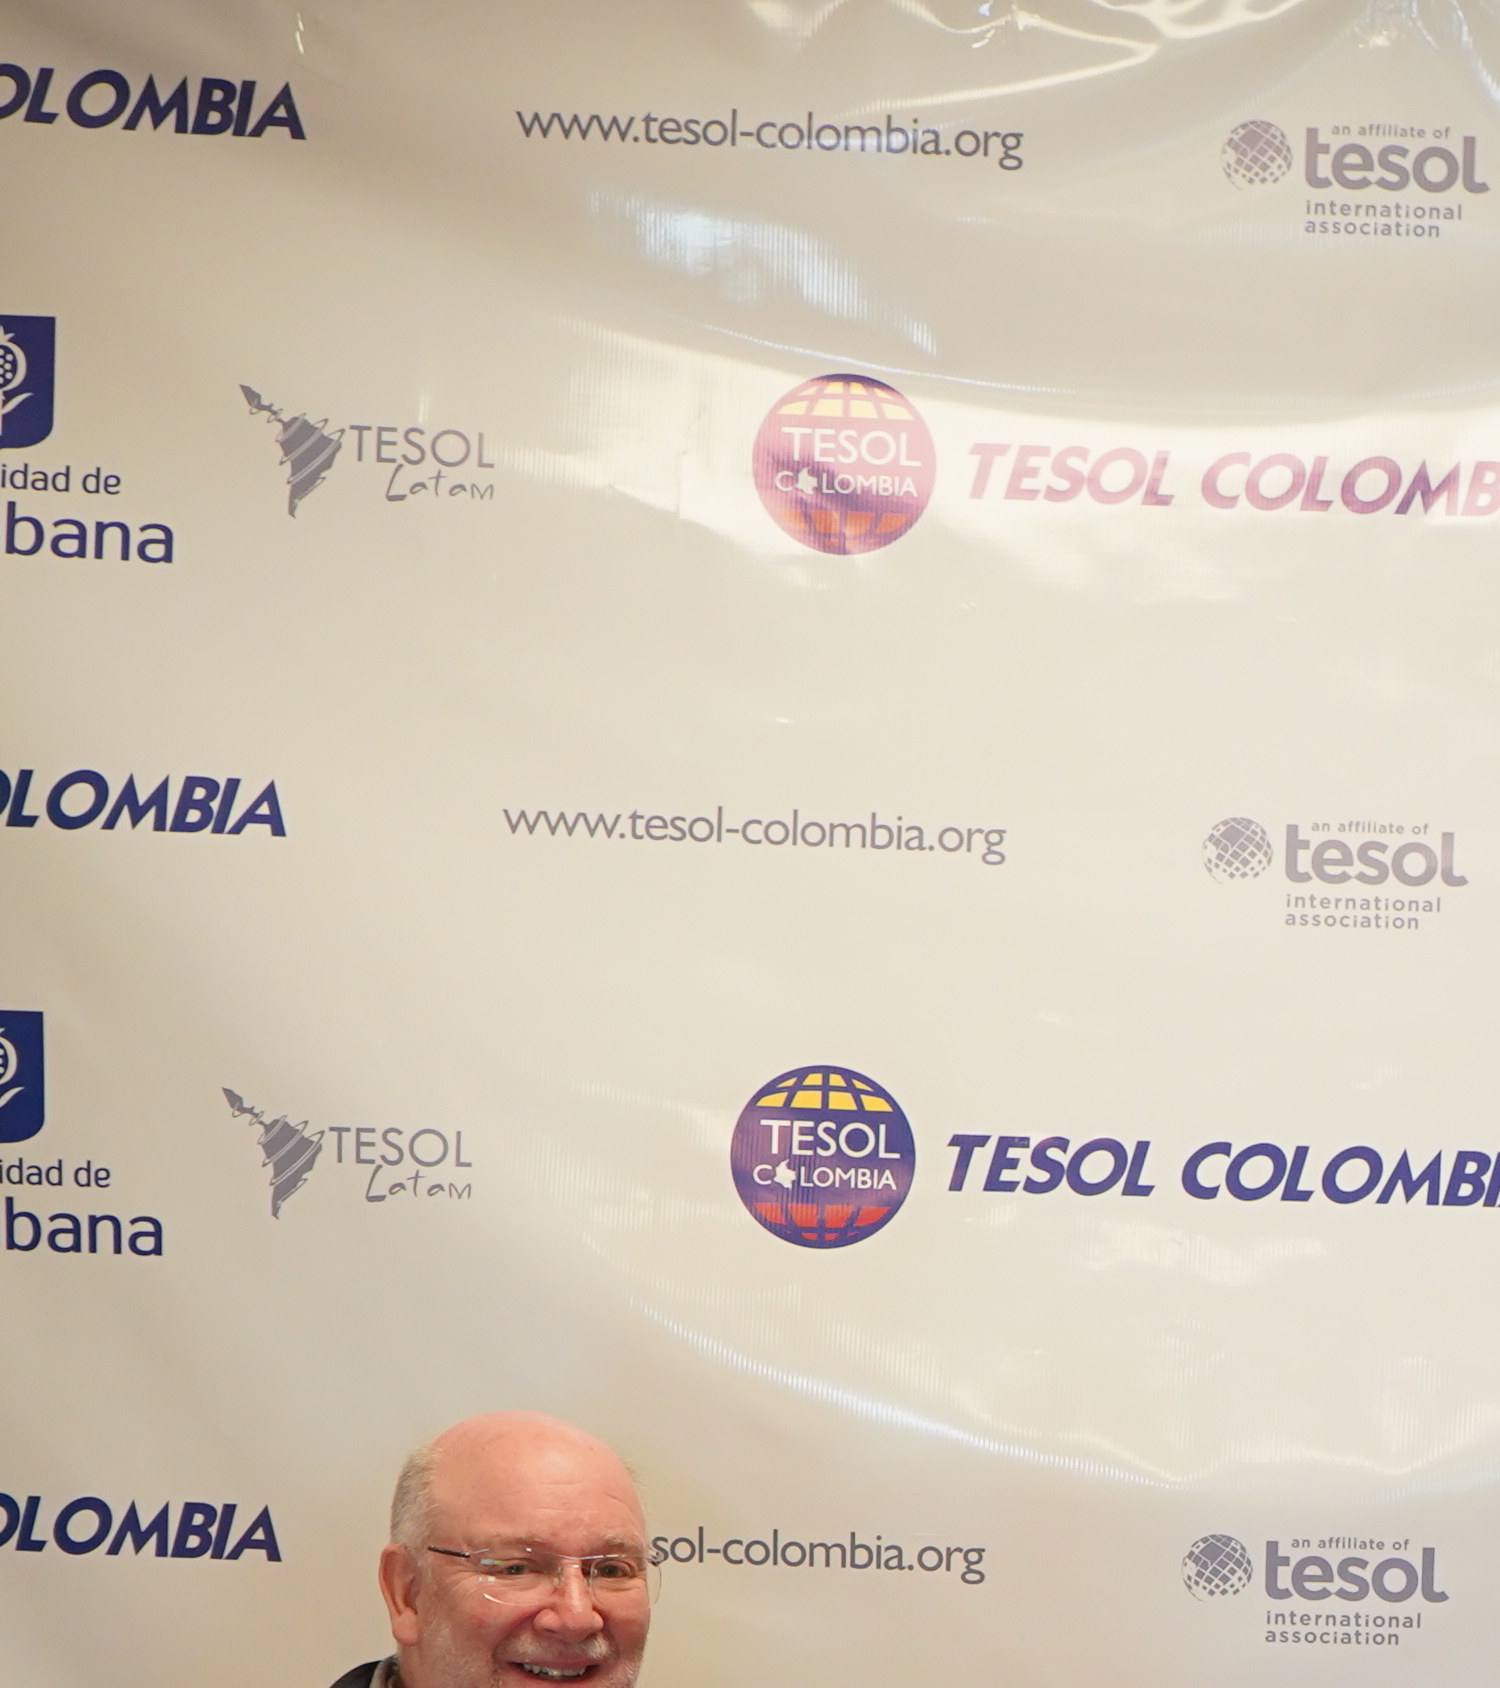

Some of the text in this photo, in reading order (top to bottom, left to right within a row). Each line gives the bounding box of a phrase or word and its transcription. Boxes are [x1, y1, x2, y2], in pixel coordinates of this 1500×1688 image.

[514, 108, 1025, 171] www.tesol-colombia.org
[1330, 123, 1451, 140] an affiliate of
[1305, 127, 1491, 196] tesol
[1304, 220, 1440, 238] association
[1306, 199, 1463, 221] international
[348, 424, 495, 469] TESOL
[781, 427, 922, 467] TESOL
[81, 466, 122, 496] de
[384, 462, 495, 503] Latam
[968, 442, 1177, 508] TESOL
[502, 805, 1007, 866] www.tesol-colombia.org
[1310, 820, 1429, 836] an affiliate of
[1284, 822, 1470, 888] tesol
[1284, 913, 1419, 931] association
[1286, 893, 1441, 913] international
[328, 1126, 473, 1168] TESOL
[759, 1118, 901, 1159] TESOL
[73, 1159, 111, 1189] de
[365, 1163, 472, 1203] Latam
[946, 1133, 1156, 1198] TESOL
[651, 1526, 986, 1585] sol-colombia.org
[1290, 1536, 1410, 1551] an affiliate of
[1264, 1539, 1450, 1604] tesol
[1264, 1629, 1400, 1646] association
[1266, 1610, 1422, 1629] international
